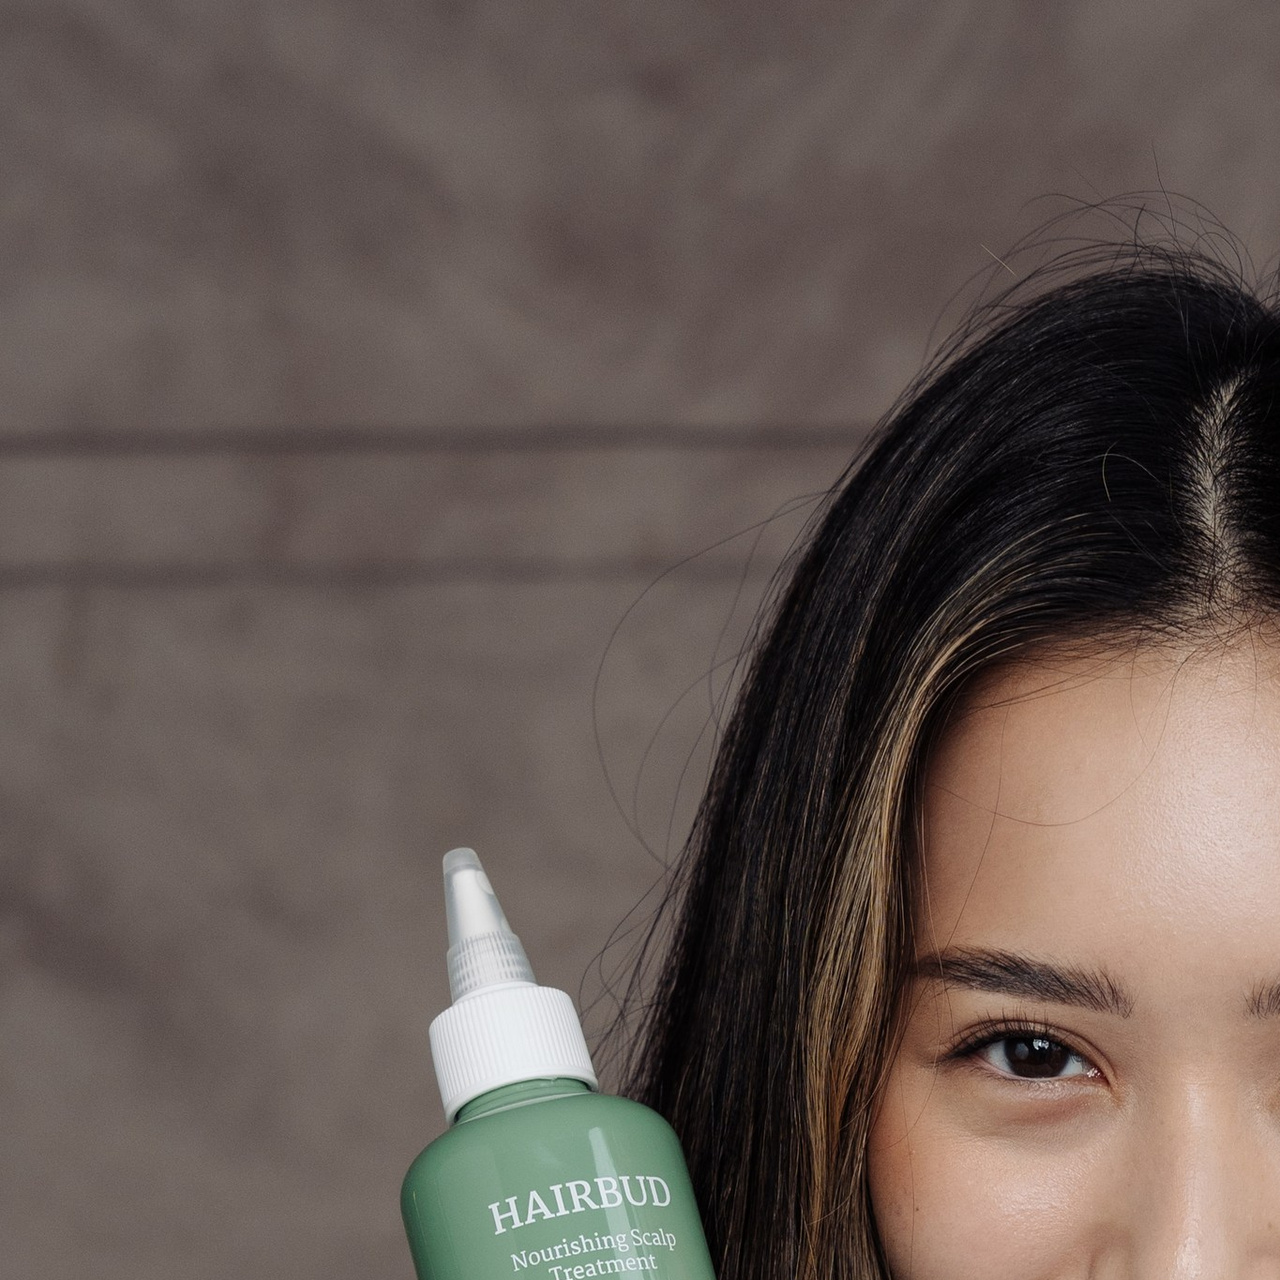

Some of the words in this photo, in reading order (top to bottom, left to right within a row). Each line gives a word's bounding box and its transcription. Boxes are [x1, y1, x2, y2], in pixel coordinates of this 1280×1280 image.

[488, 1175, 671, 1236] HAIRBUD
[510, 1231, 630, 1272] Nourishing
[630, 1228, 677, 1251] Scalp
